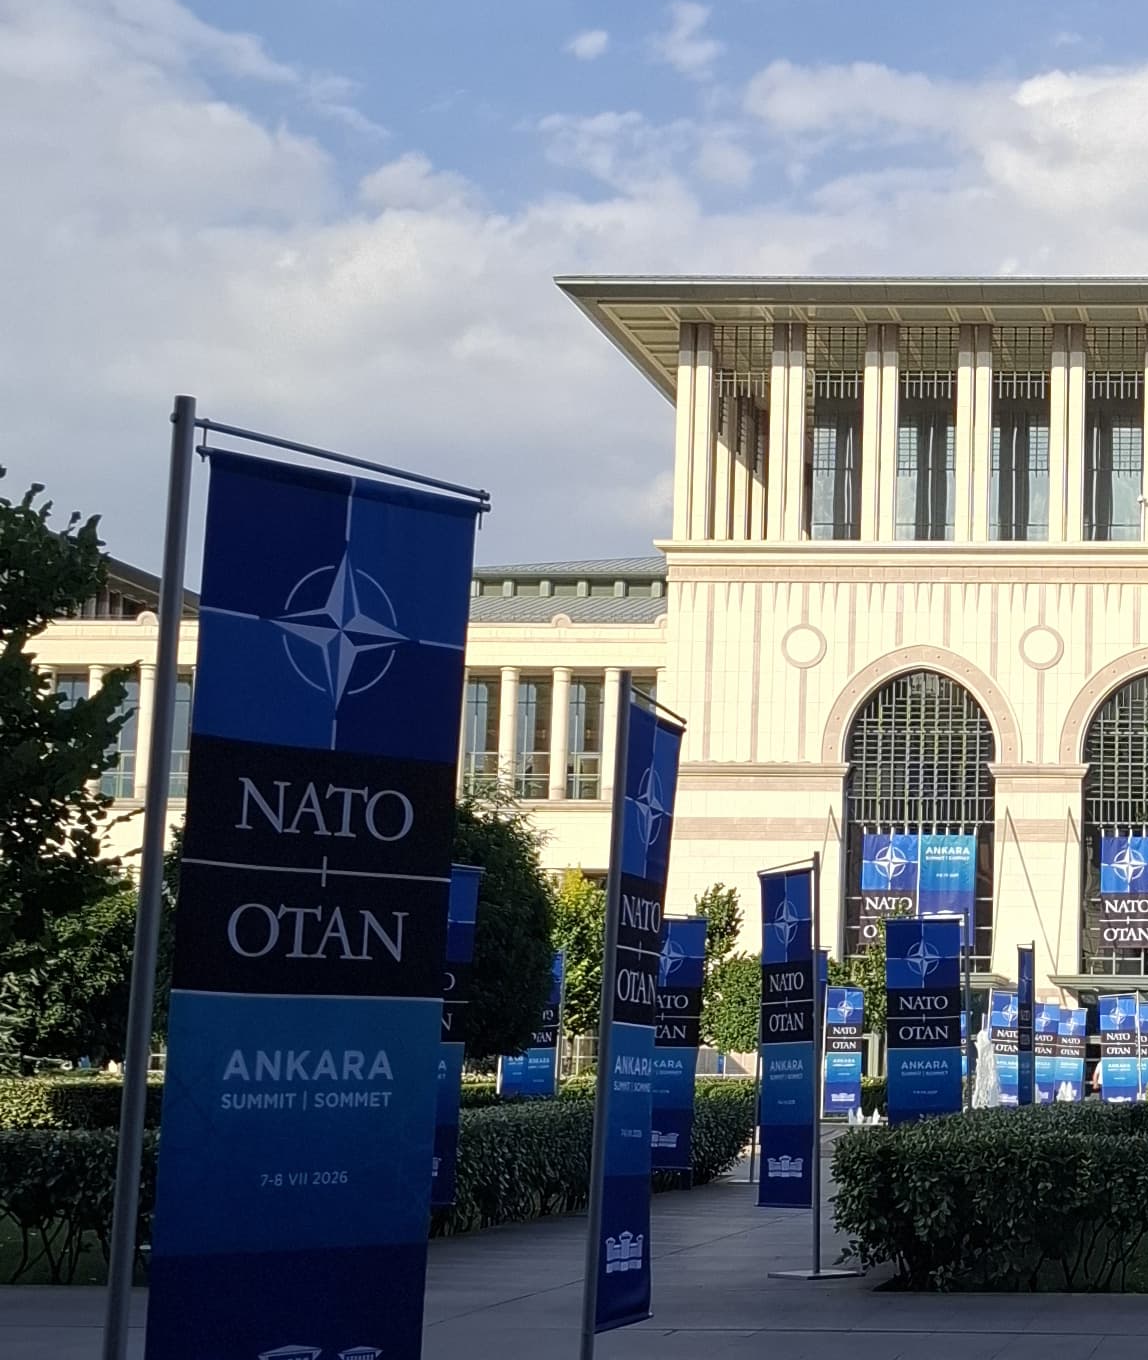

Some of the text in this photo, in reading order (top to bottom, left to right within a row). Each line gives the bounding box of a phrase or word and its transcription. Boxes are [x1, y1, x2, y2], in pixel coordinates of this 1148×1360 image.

[235, 777, 414, 841] NATO
[925, 847, 971, 855] ANKARA
[621, 894, 660, 934] NATO
[227, 903, 409, 963] OTAN
[617, 968, 657, 1005] OTAN
[769, 971, 804, 992] NATO
[656, 994, 689, 1009] ATO
[899, 995, 949, 1010] NATO
[769, 1012, 804, 1032] OTAN
[655, 1025, 687, 1039] TAN
[832, 1026, 857, 1035] NATO
[899, 1025, 949, 1040] OTAN
[1106, 1032, 1131, 1041] NATO
[832, 1041, 857, 1049] OTAN
[1061, 1037, 1081, 1045] NATO
[1106, 1046, 1131, 1055] OTAN
[222, 1049, 394, 1081] ANKARA
[770, 1059, 803, 1071] ANKARA
[901, 1060, 949, 1070] ANKARA
[221, 1092, 297, 1110] SUMMIT
[314, 1091, 393, 1108] SOMMET
[260, 1170, 349, 1187] 7-8 VII 2026
